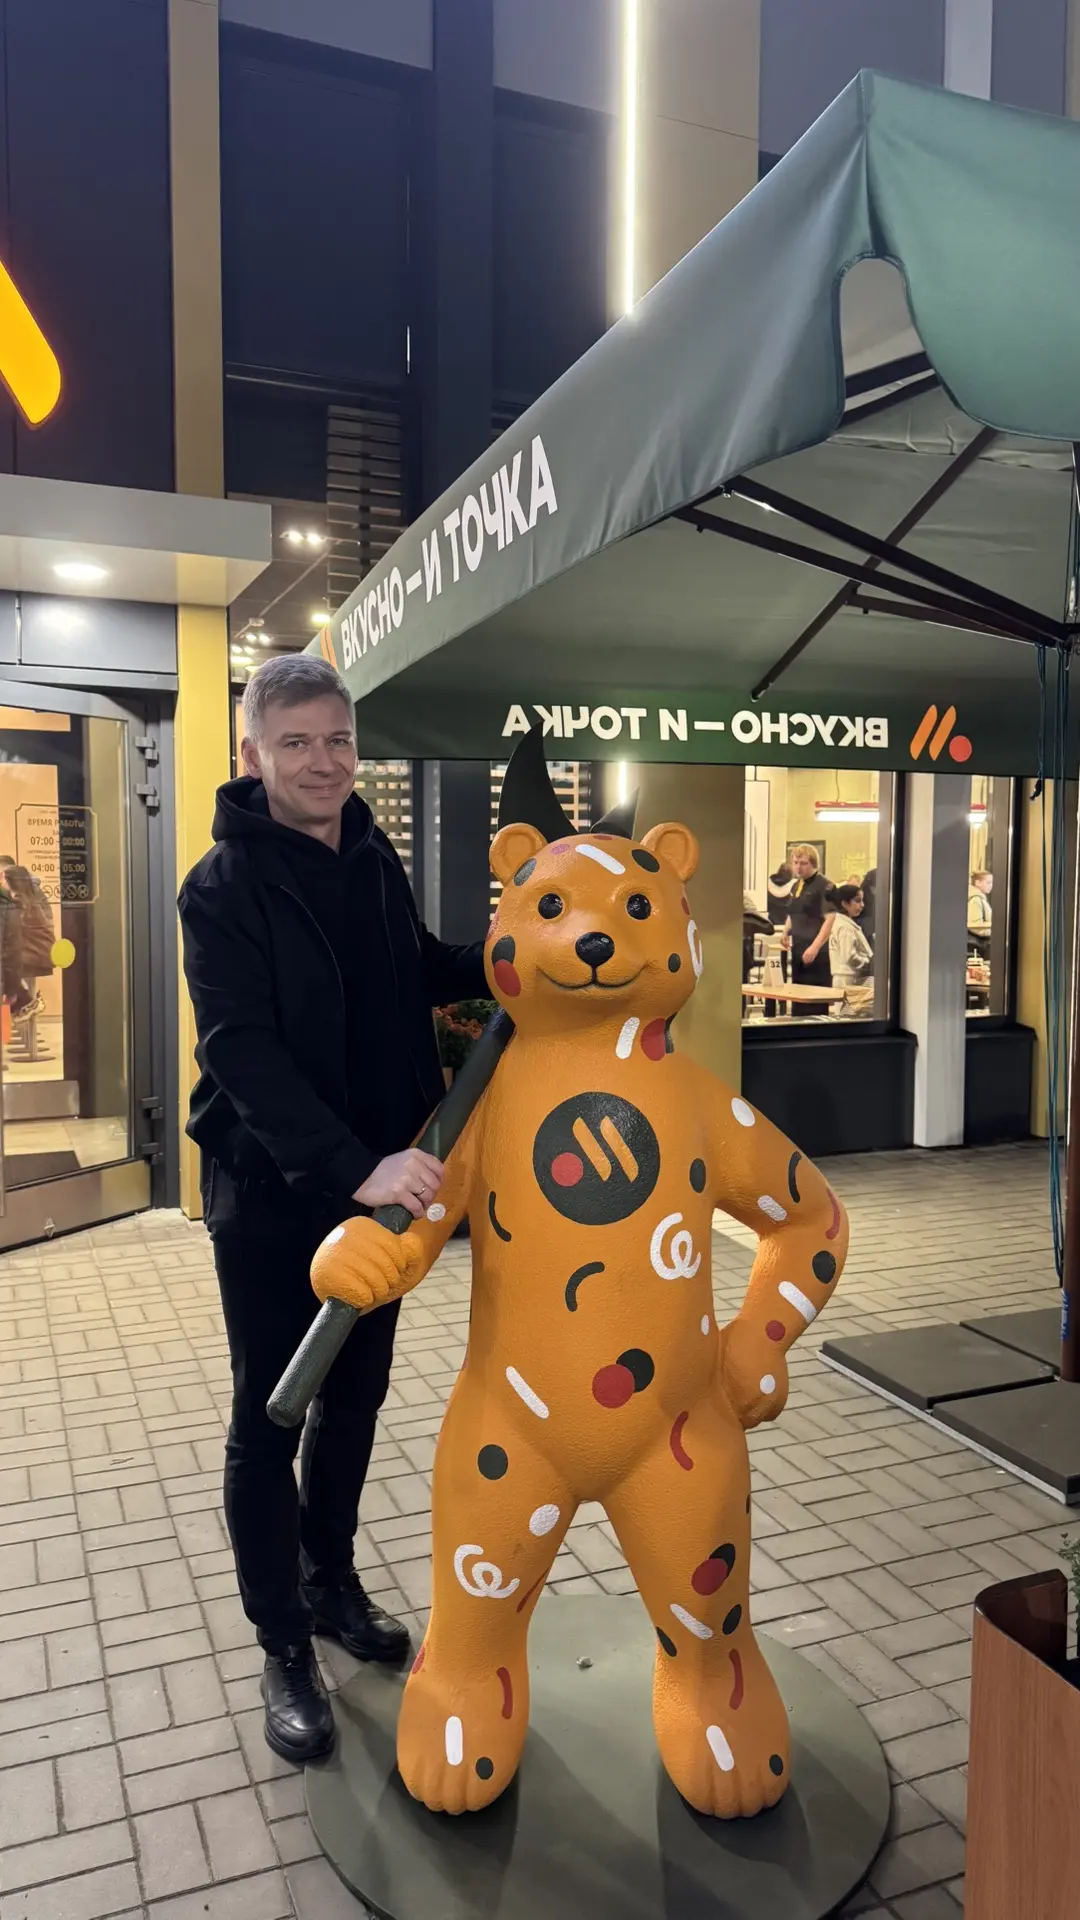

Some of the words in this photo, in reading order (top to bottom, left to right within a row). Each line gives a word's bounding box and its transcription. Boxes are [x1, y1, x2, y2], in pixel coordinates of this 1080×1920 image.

[341, 567, 404, 670] ВКУСНО
[443, 434, 558, 583] ТОЧКА
[28, 818, 52, 826] ВРЕМЯ
[30, 836, 54, 845] 07:00
[62, 837, 85, 846] 00:00
[31, 864, 55, 872] 04:00
[63, 864, 86, 872] 05:00
[770, 960, 781, 968] 32
